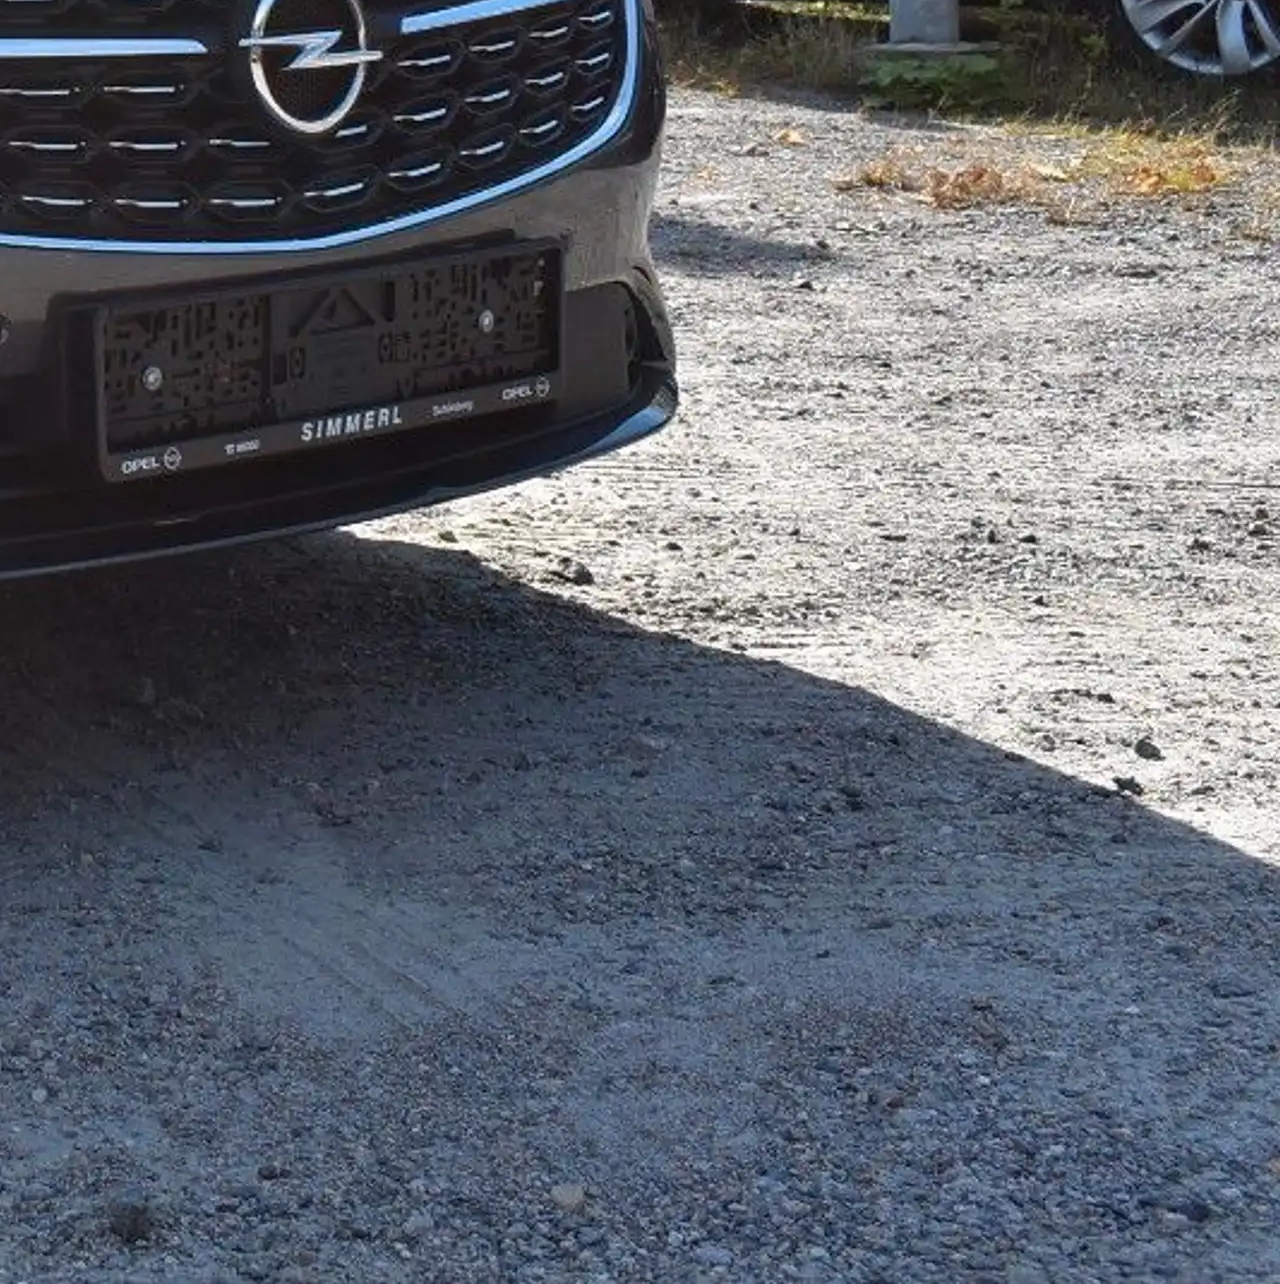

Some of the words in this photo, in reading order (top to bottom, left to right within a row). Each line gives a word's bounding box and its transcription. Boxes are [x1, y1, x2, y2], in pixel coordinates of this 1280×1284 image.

[120, 456, 161, 475] OPEL
[300, 405, 403, 443] SIMMERL
[502, 385, 534, 401] OPEL
